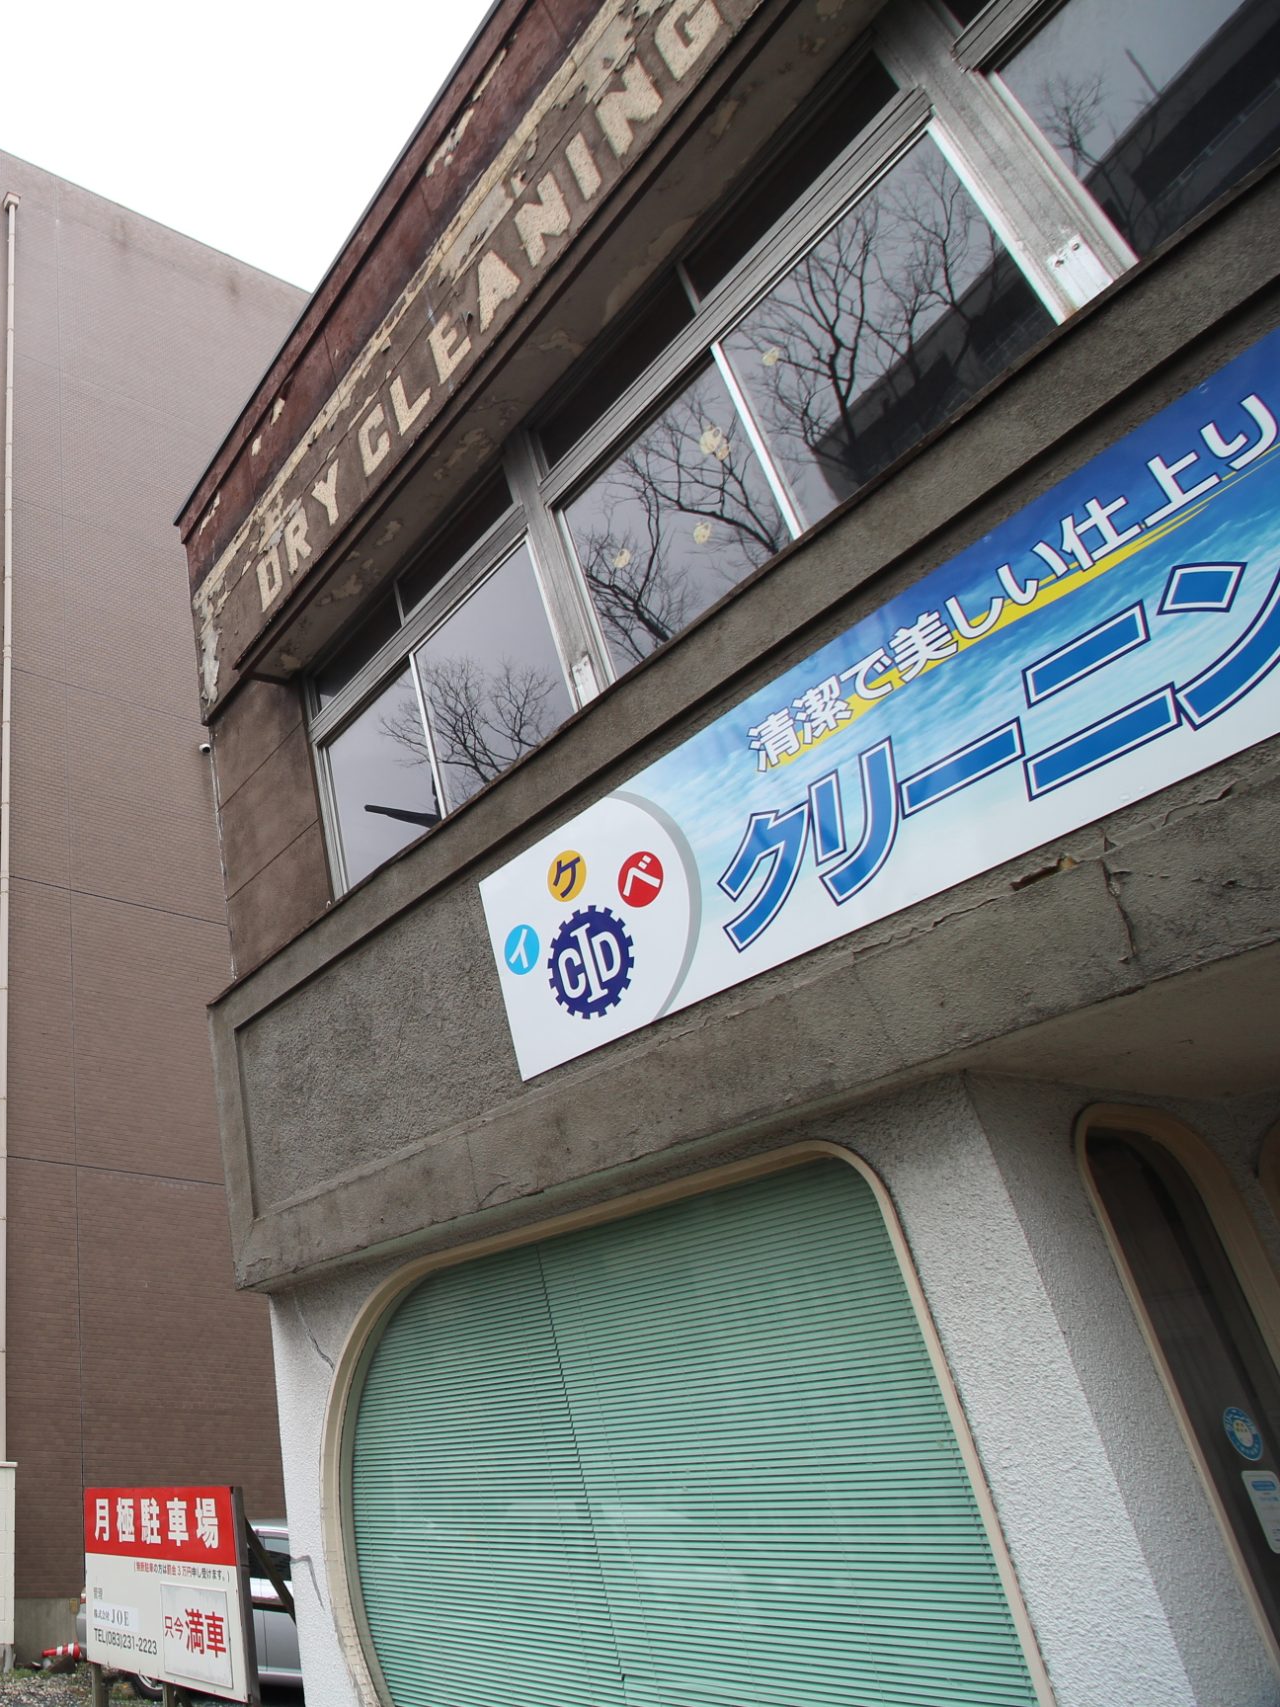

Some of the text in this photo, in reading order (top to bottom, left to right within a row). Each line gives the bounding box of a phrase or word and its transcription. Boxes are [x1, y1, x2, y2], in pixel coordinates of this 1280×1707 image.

[257, 0, 724, 613] DRY CLEANING
[746, 393, 1279, 774] 清潔で美しい仕上り
[558, 922, 621, 1004] CID
[94, 1497, 219, 1549] 月極駐車場
